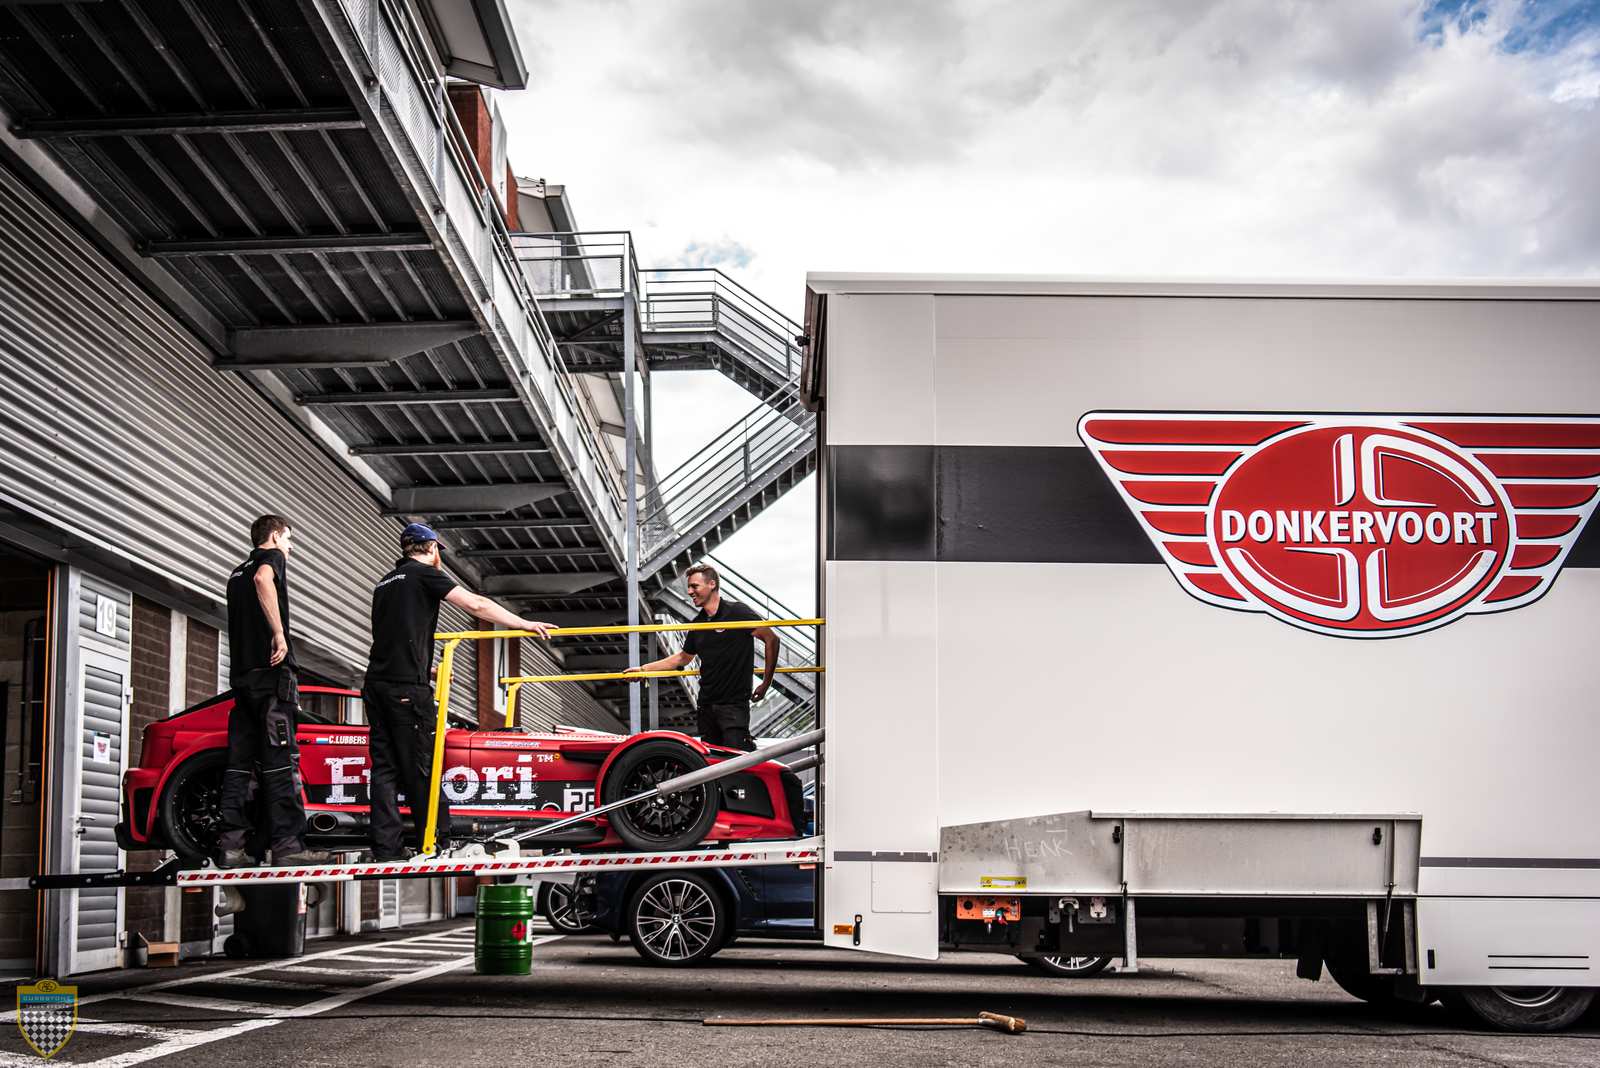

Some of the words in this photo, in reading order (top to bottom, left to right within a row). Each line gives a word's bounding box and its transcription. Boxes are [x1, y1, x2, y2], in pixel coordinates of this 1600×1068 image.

[1221, 509, 1498, 544] DONKERVOORT
[100, 601, 115, 633] 19
[328, 735, 367, 745] C.LUBBERS
